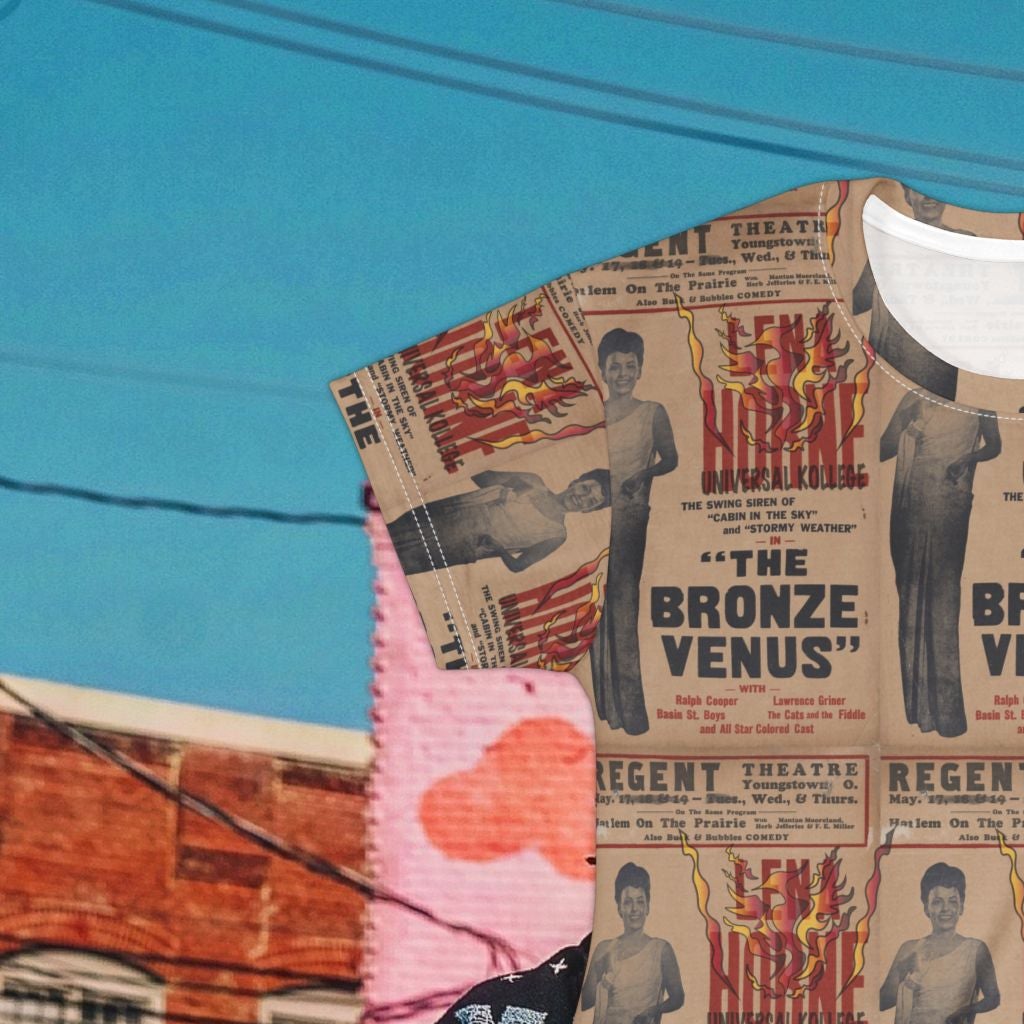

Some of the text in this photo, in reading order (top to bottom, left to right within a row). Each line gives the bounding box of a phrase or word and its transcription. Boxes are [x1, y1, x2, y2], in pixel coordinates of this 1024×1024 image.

[730, 219, 826, 236] THEATR
[688, 277, 737, 291] Prairie
[737, 289, 781, 300] COMEDY
[395, 375, 412, 404] SIREN
[701, 463, 866, 495] UNIVERSAL KOLLEGE
[681, 497, 795, 511] THE SWING SIREN OF
[750, 511, 761, 520] IN
[766, 511, 787, 520] THE
[723, 525, 741, 535] and
[650, 584, 859, 629] BRONZE
[740, 763, 859, 776] THEATRE
[889, 794, 922, 806] May.
[950, 818, 969, 828] On
[977, 818, 1003, 828] The
